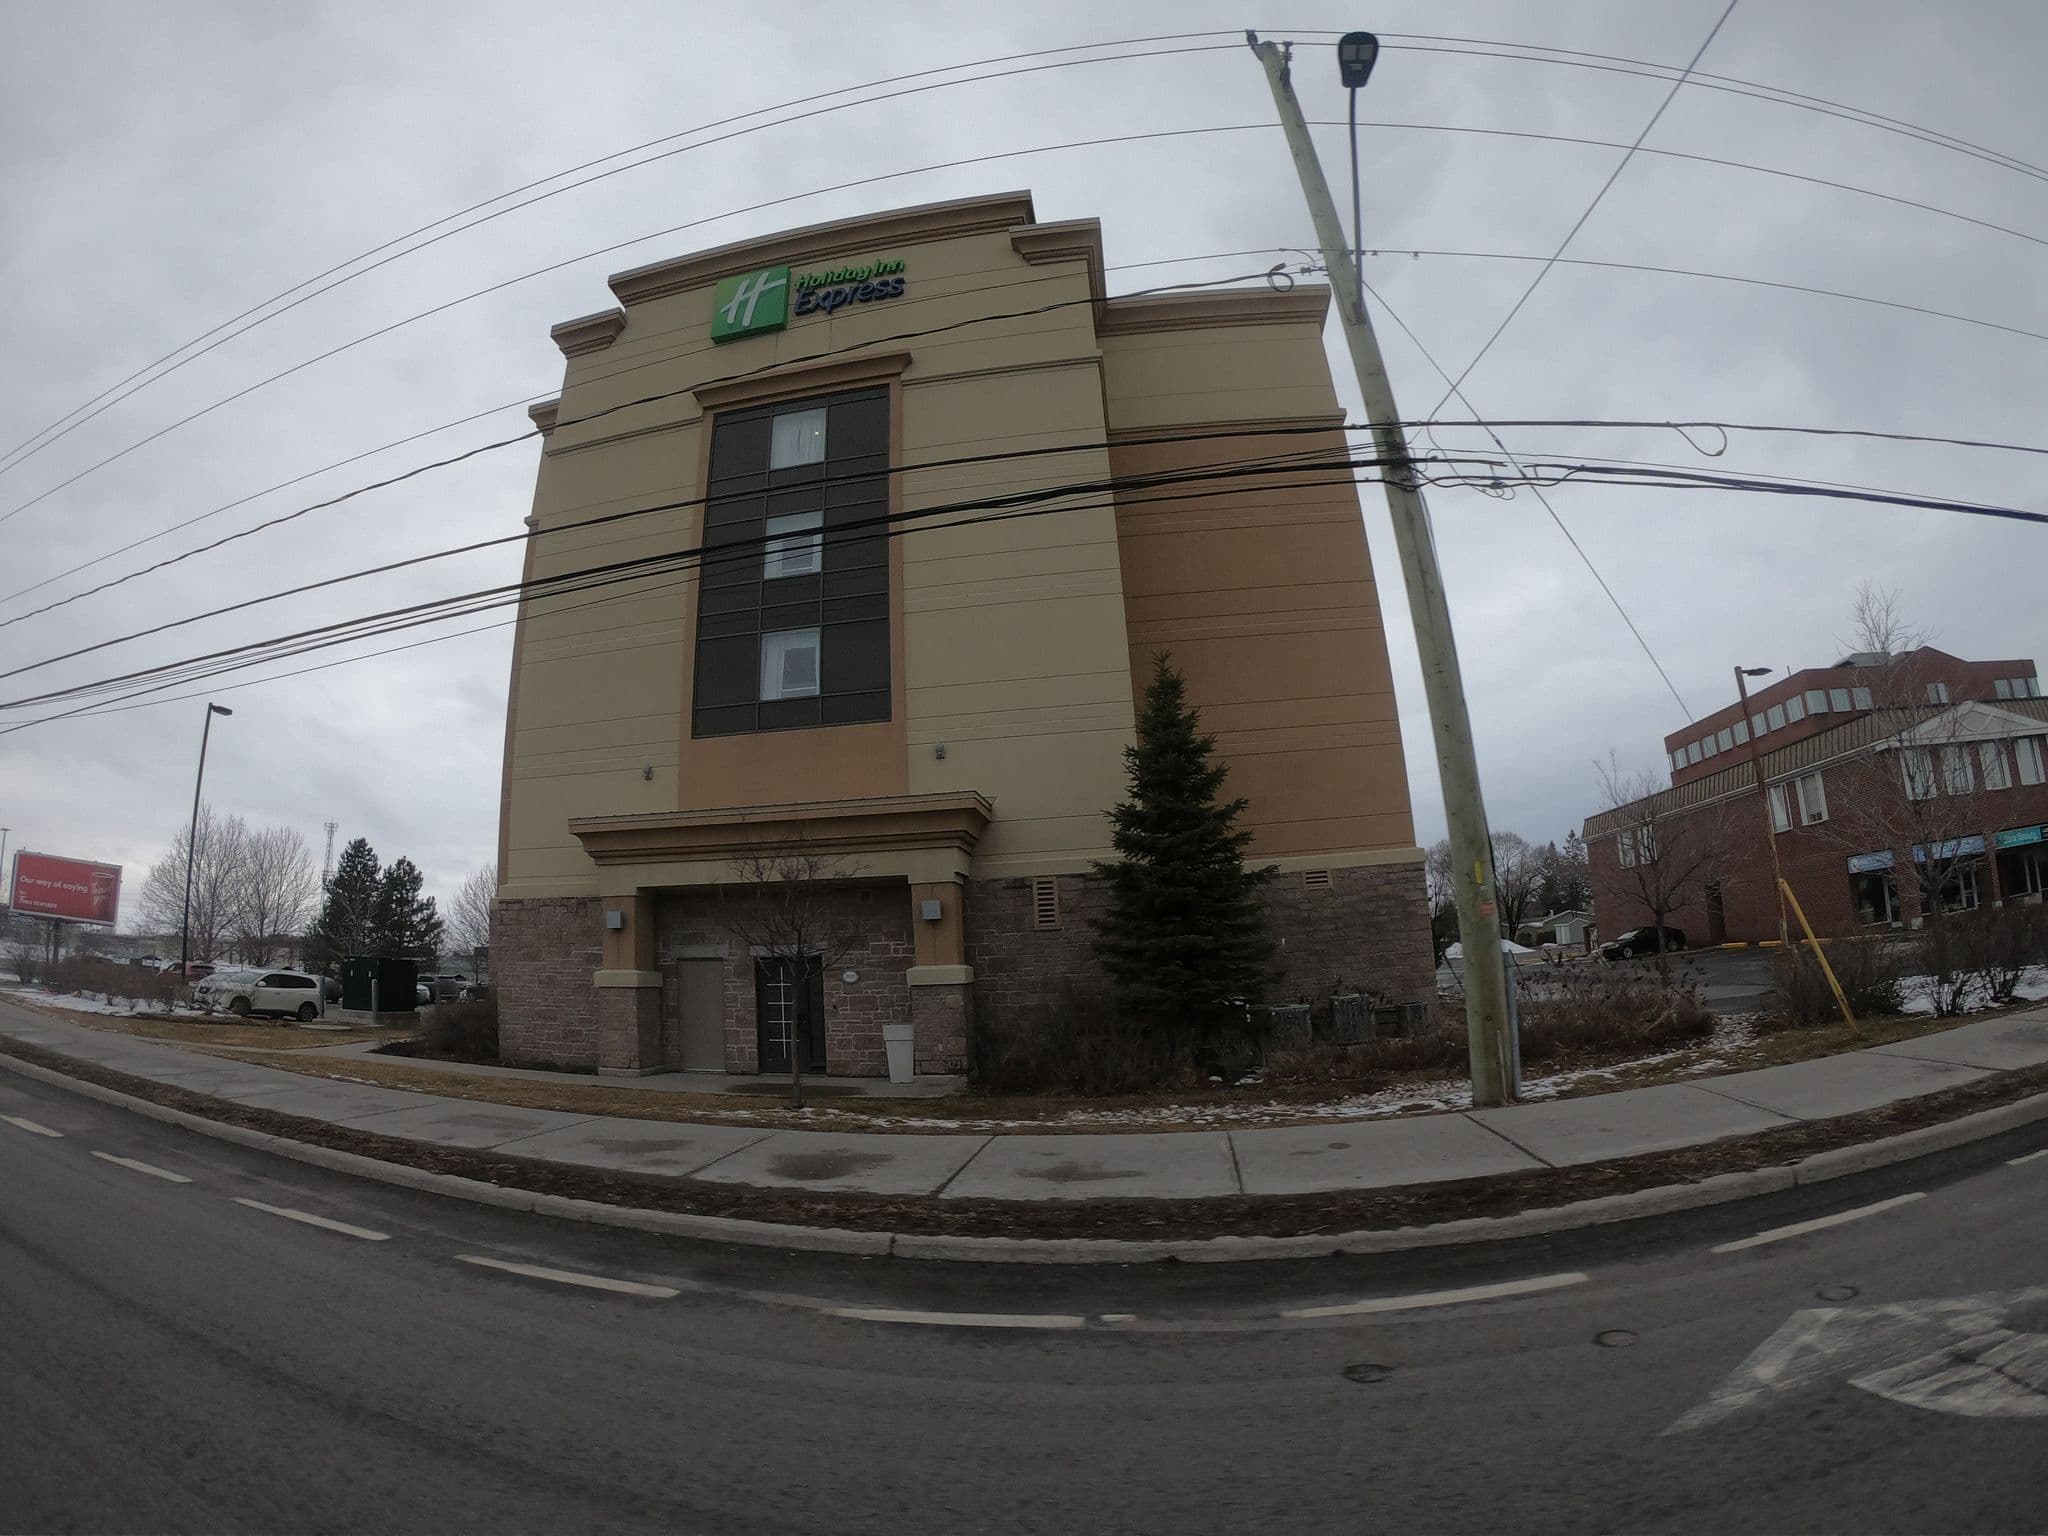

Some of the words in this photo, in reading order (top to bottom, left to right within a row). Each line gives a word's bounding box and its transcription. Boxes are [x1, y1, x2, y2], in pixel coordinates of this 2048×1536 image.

[796, 265, 871, 291] Holiday
[873, 258, 906, 278] Inn
[720, 271, 786, 327] H
[795, 276, 906, 316] Express
[20, 875, 35, 884] Our
[36, 880, 52, 888] way
[53, 880, 62, 888] of
[63, 882, 88, 893] saying
